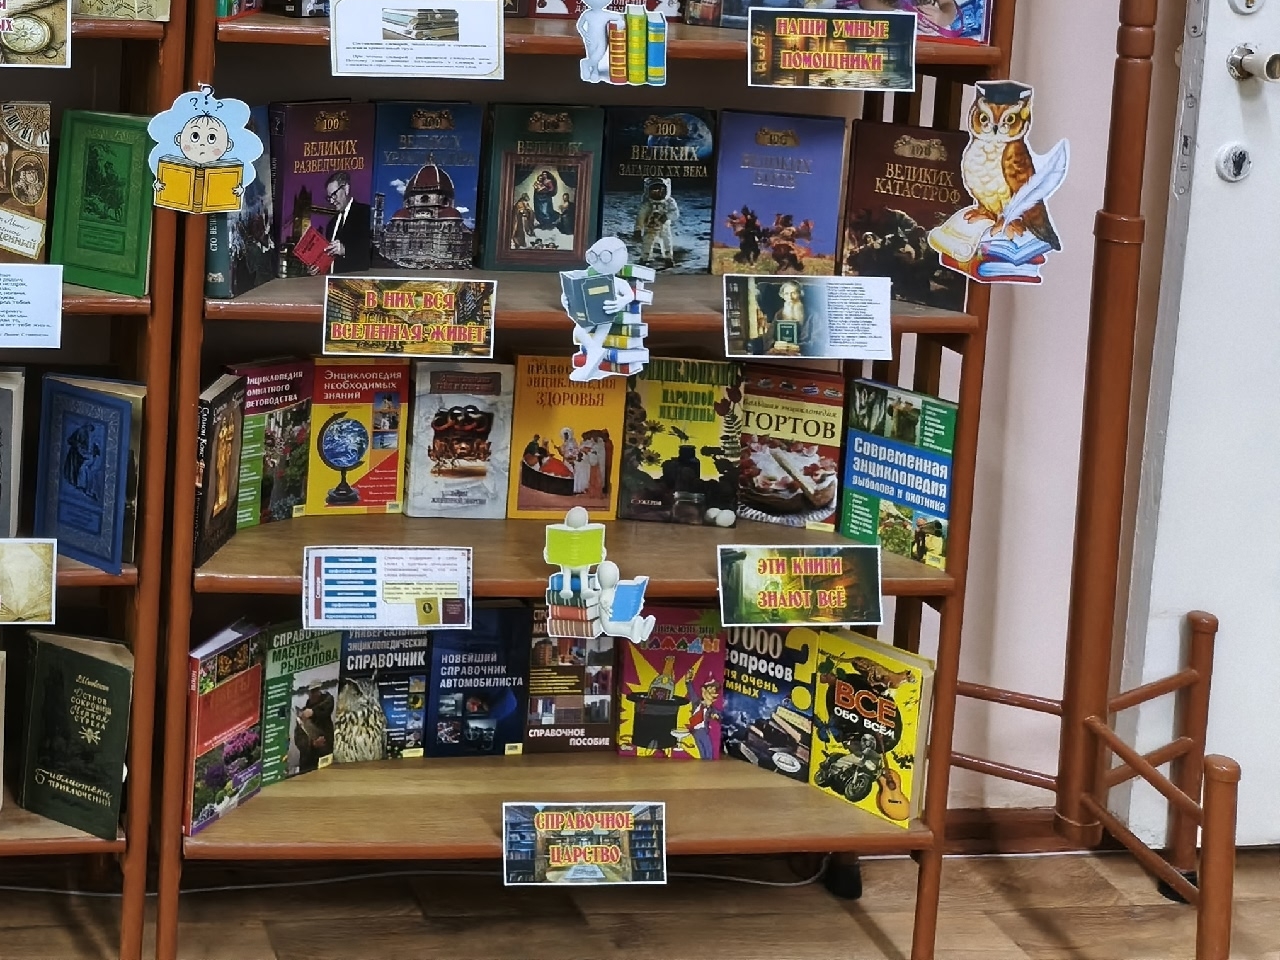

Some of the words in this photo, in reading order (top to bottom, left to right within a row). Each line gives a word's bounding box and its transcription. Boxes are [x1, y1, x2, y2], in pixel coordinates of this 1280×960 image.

[775, 18, 827, 36] НАШИ
[833, 20, 890, 39] УМНЫЕ
[780, 51, 883, 71] ПОМОЩНИКИ
[303, 140, 358, 158] ВЕЛИКИХ
[631, 145, 700, 162] ВЕЛИКИХ
[294, 156, 364, 174] РАЗВЕДЧИКОВ
[683, 164, 708, 177] ВЕКА
[885, 162, 955, 187] ВЕЛИКИХ
[875, 178, 961, 205] КАТАСТРОФ
[366, 291, 377, 310] В
[384, 292, 414, 310] НИХ
[423, 292, 455, 310] ВСЯ
[536, 391, 604, 408] ЗДОРОВЬЯ
[744, 411, 836, 439] ТОРТОВ
[854, 437, 948, 479] Современная
[852, 457, 947, 498] энциклопедия
[757, 557, 785, 575] ЭТИ
[792, 557, 842, 575] КНИГИ
[757, 590, 812, 608] ЗНАЮТ
[818, 586, 846, 608] ВСЁ
[280, 647, 339, 674] РЫБОЛОВА
[346, 650, 426, 671] СПРАВОЧНИК
[441, 651, 497, 664] НОВЕЙШИЙ
[440, 665, 507, 676] СПРАВОЧНИК
[440, 676, 523, 688] АВТОМОБИЛИСТА
[741, 672, 779, 693] очень
[835, 680, 897, 728] ВСЕ
[834, 706, 858, 724] ОБО
[528, 728, 585, 738] СПРАВОЧНОЕ
[569, 737, 610, 746] ПОСОБИЕ
[534, 811, 634, 830] СПРАВОЧНОЕ
[549, 845, 621, 863] ЦАРСТВО
